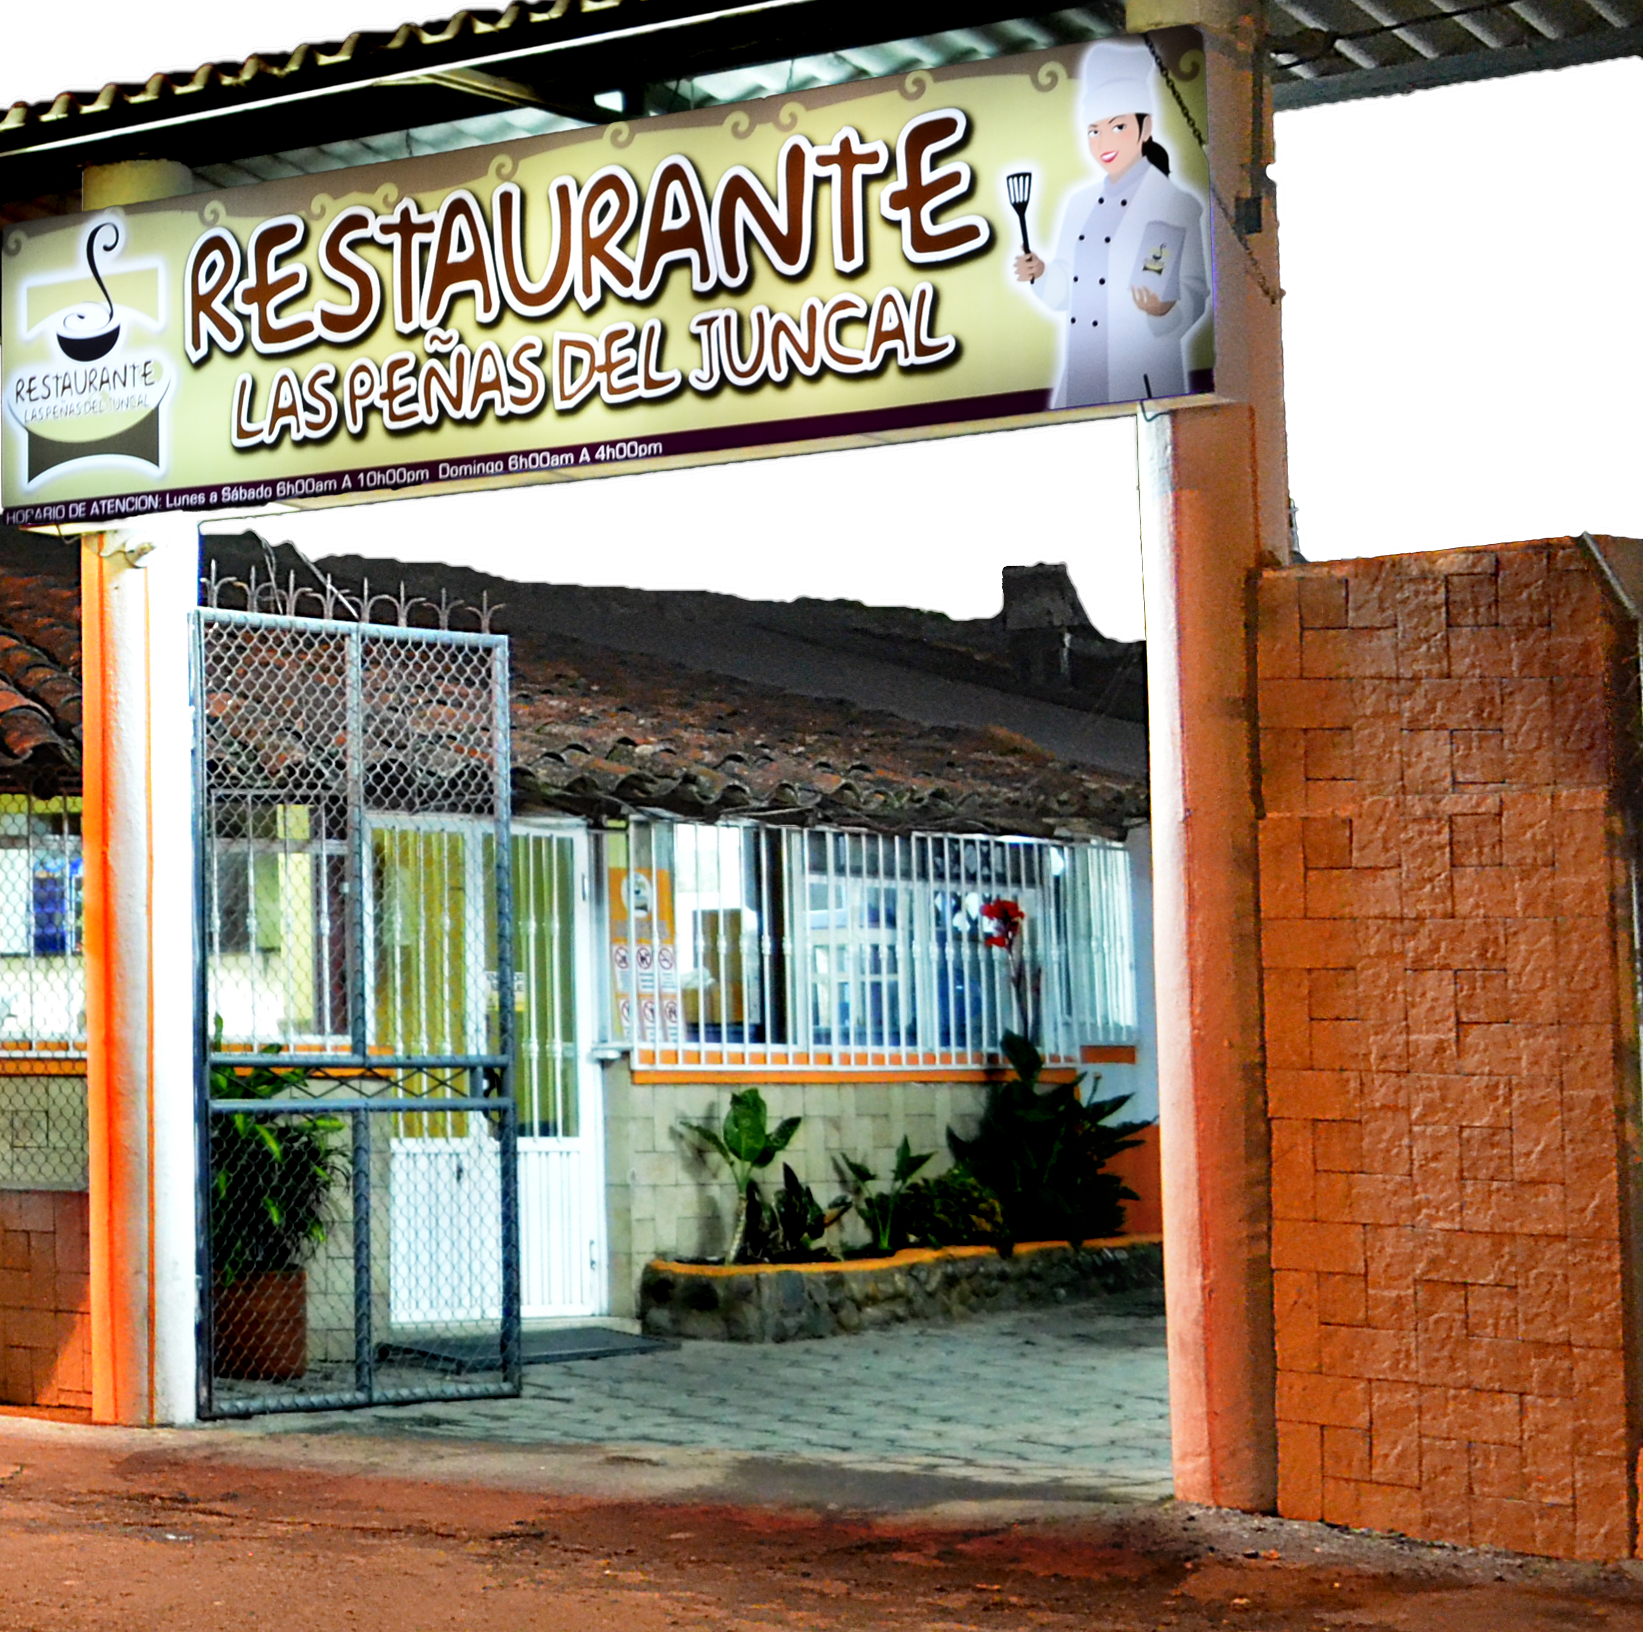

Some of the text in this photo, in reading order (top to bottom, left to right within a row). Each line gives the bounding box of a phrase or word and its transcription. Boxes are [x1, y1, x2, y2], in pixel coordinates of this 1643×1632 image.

[185, 108, 990, 365] RESTAURANTE
[15, 359, 156, 405] RESTAURANTE
[232, 281, 956, 447] LAS PEÑAS DEL JUNCAL
[24, 405, 44, 424] LAS
[84, 397, 105, 414] DEL
[68, 501, 87, 519] DE
[166, 492, 206, 509] Lunes
[209, 491, 218, 505] a
[221, 483, 273, 503] Sábado
[276, 477, 337, 498] 6h00am
[341, 474, 353, 490] A
[356, 467, 430, 488] 10h00pm
[438, 458, 504, 480] Domingo
[508, 451, 574, 471] 6h00am
[578, 447, 591, 463] A
[595, 440, 663, 460] 4h00pm
